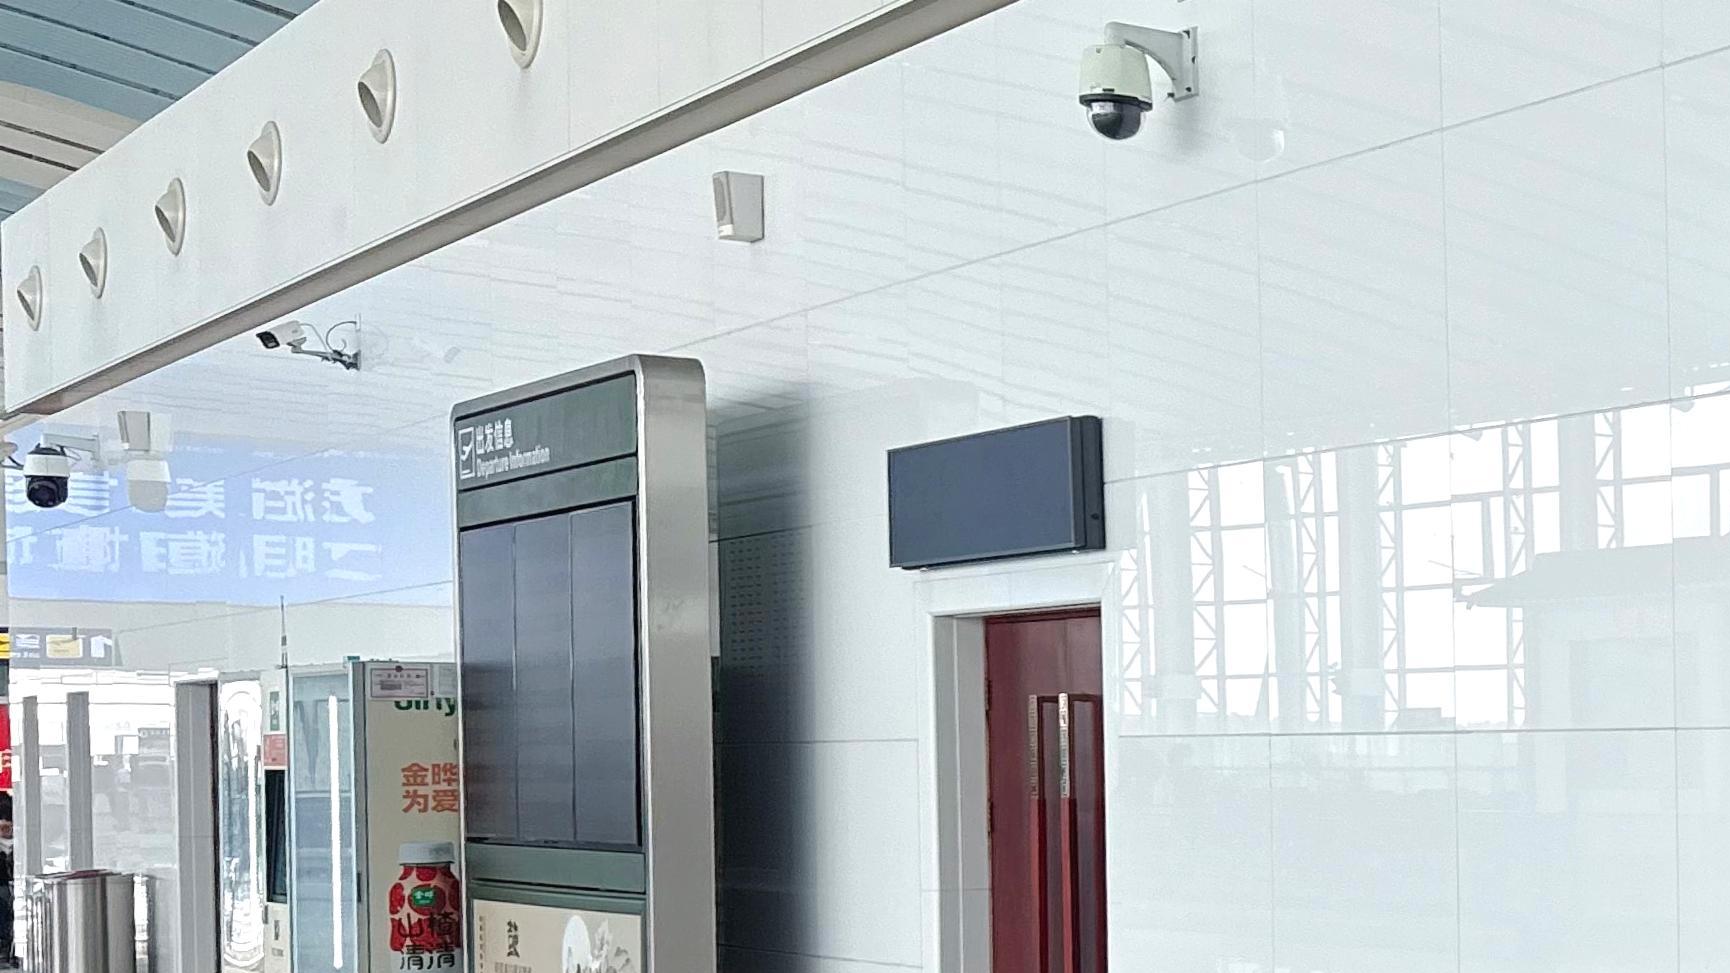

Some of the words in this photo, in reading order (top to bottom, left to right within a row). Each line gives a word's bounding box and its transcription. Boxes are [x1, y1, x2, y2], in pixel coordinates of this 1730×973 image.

[475, 418, 514, 455] 出发信息
[401, 763, 458, 787] 金晔
[402, 789, 458, 813] 为爱
[398, 911, 457, 938] 山楂
